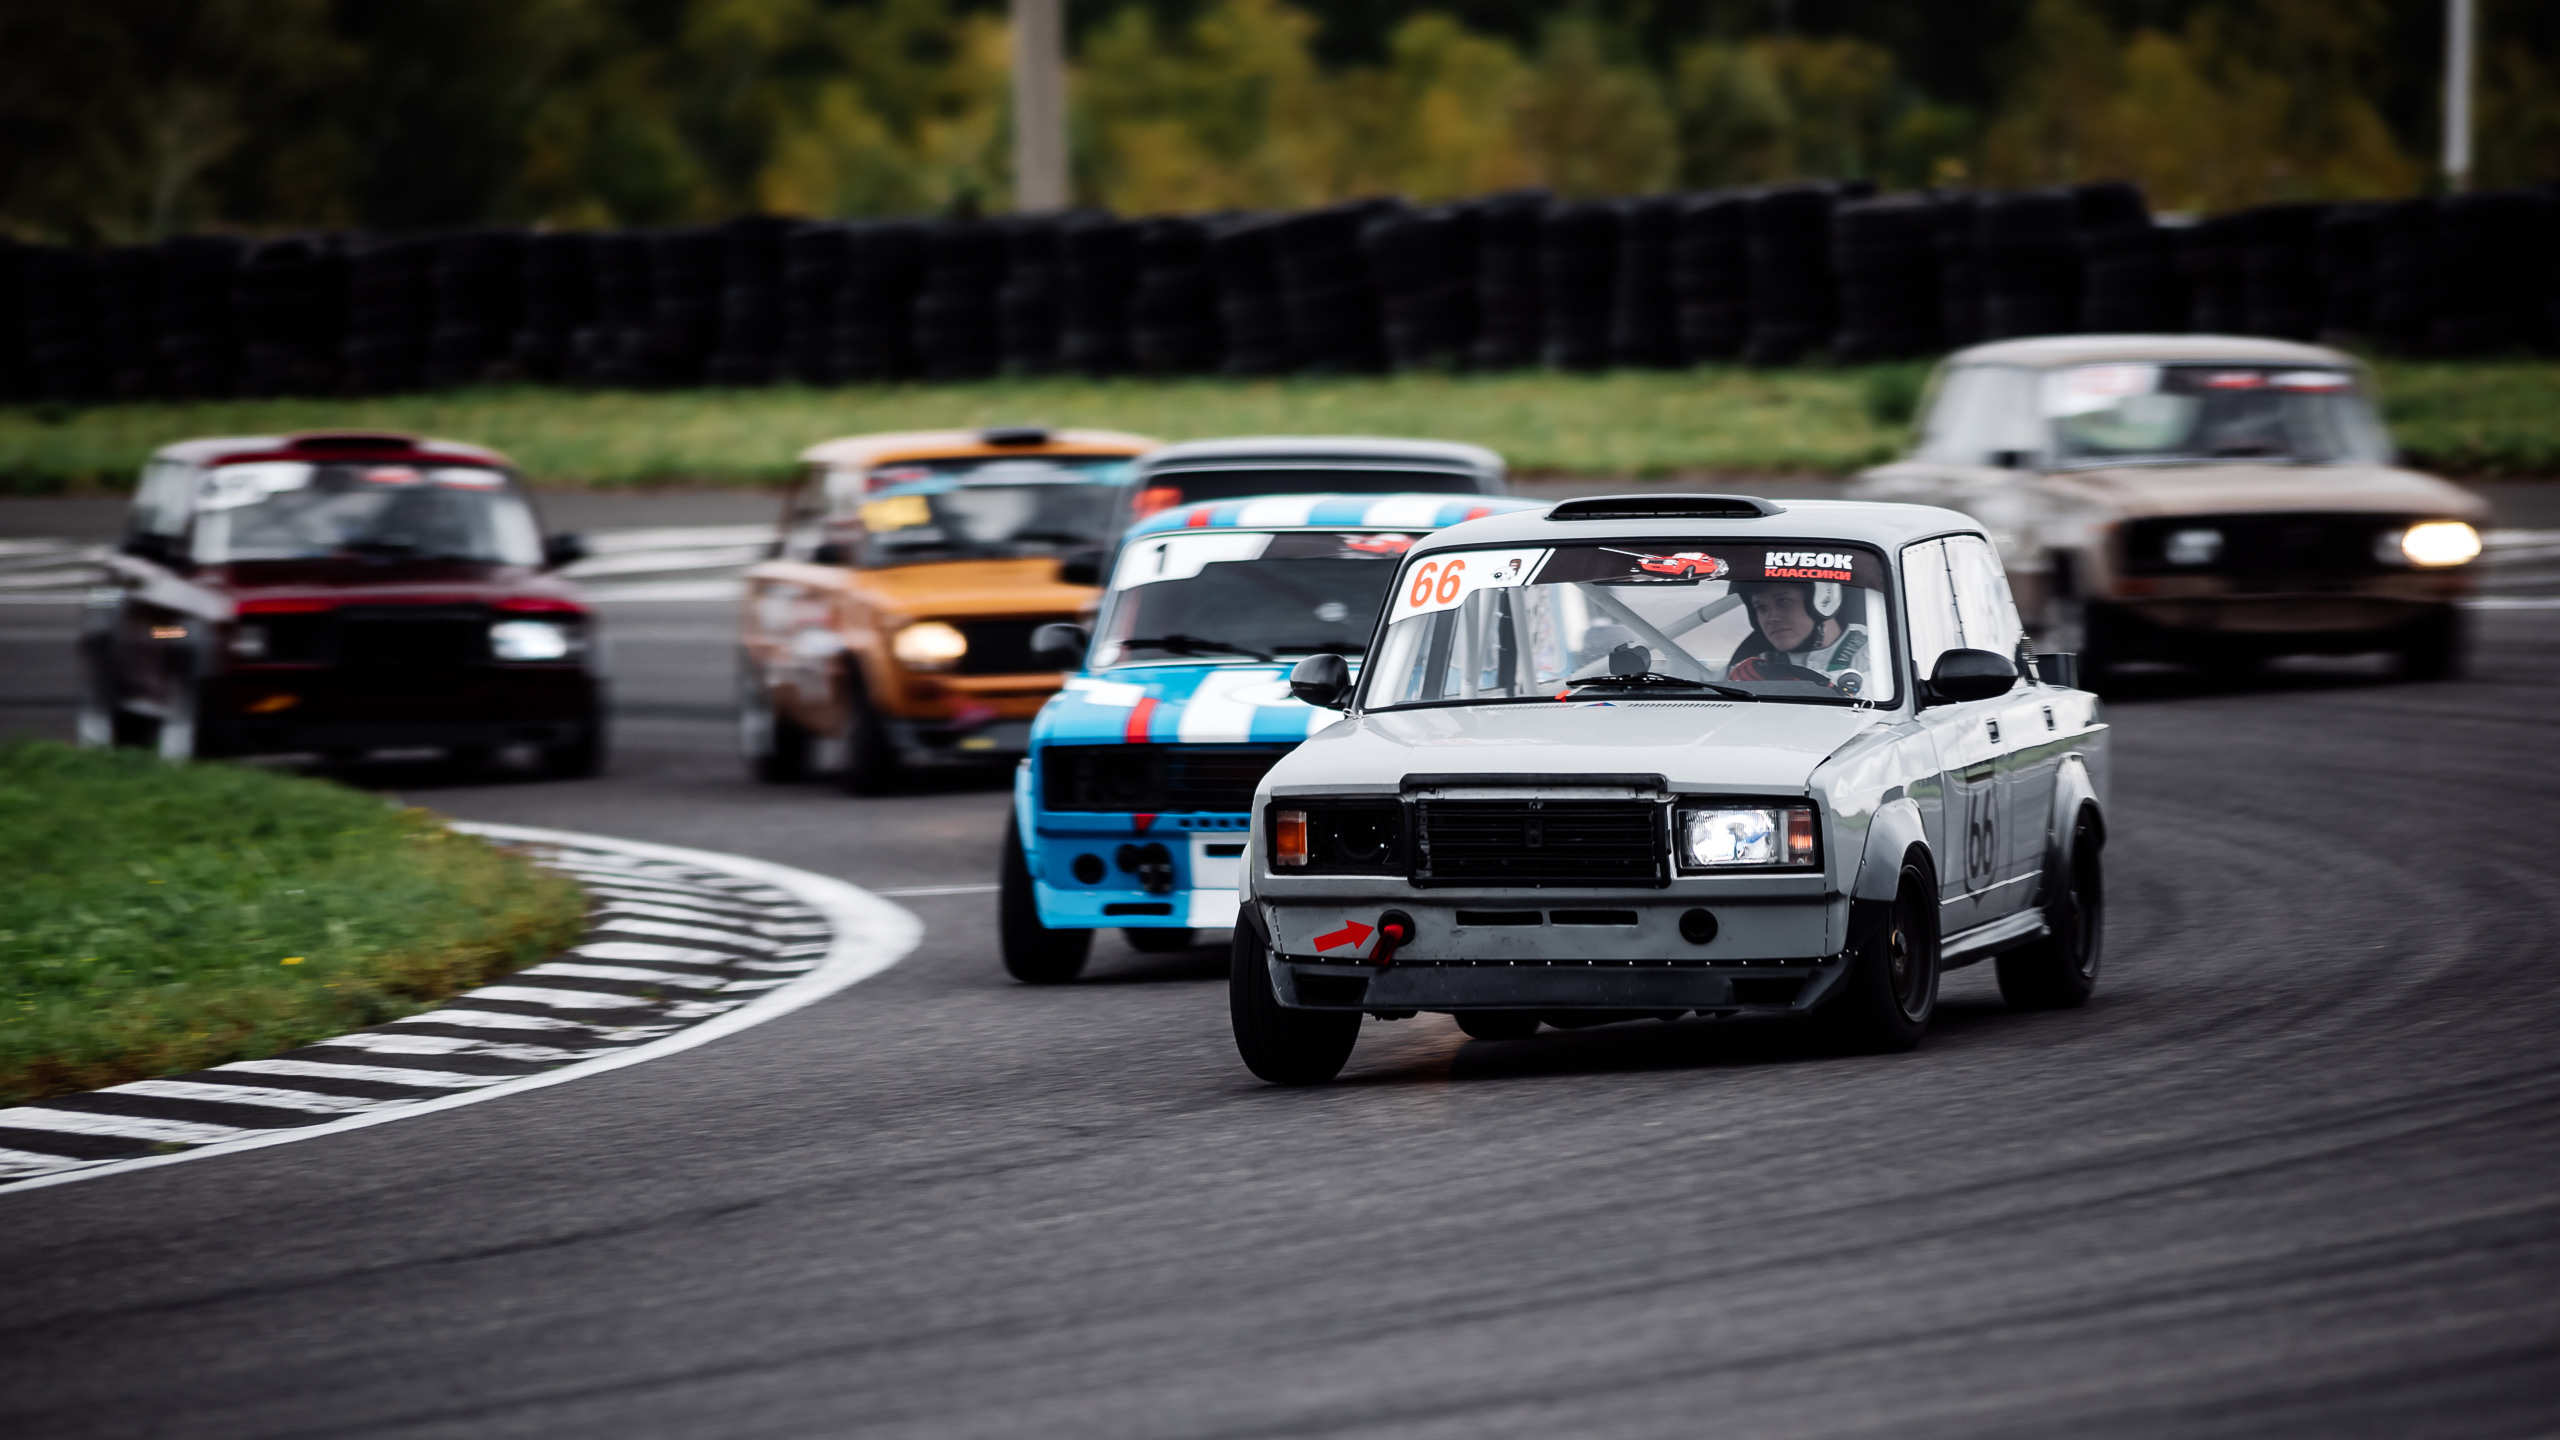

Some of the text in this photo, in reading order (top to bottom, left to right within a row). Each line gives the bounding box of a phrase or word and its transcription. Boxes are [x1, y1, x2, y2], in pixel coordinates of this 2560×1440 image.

[1156, 543, 1168, 575] 1
[1764, 568, 1852, 581] КЛАССИКИ
[1765, 552, 1853, 569] КУБОК
[1410, 559, 1466, 608] 66
[1969, 788, 1995, 879] 66
